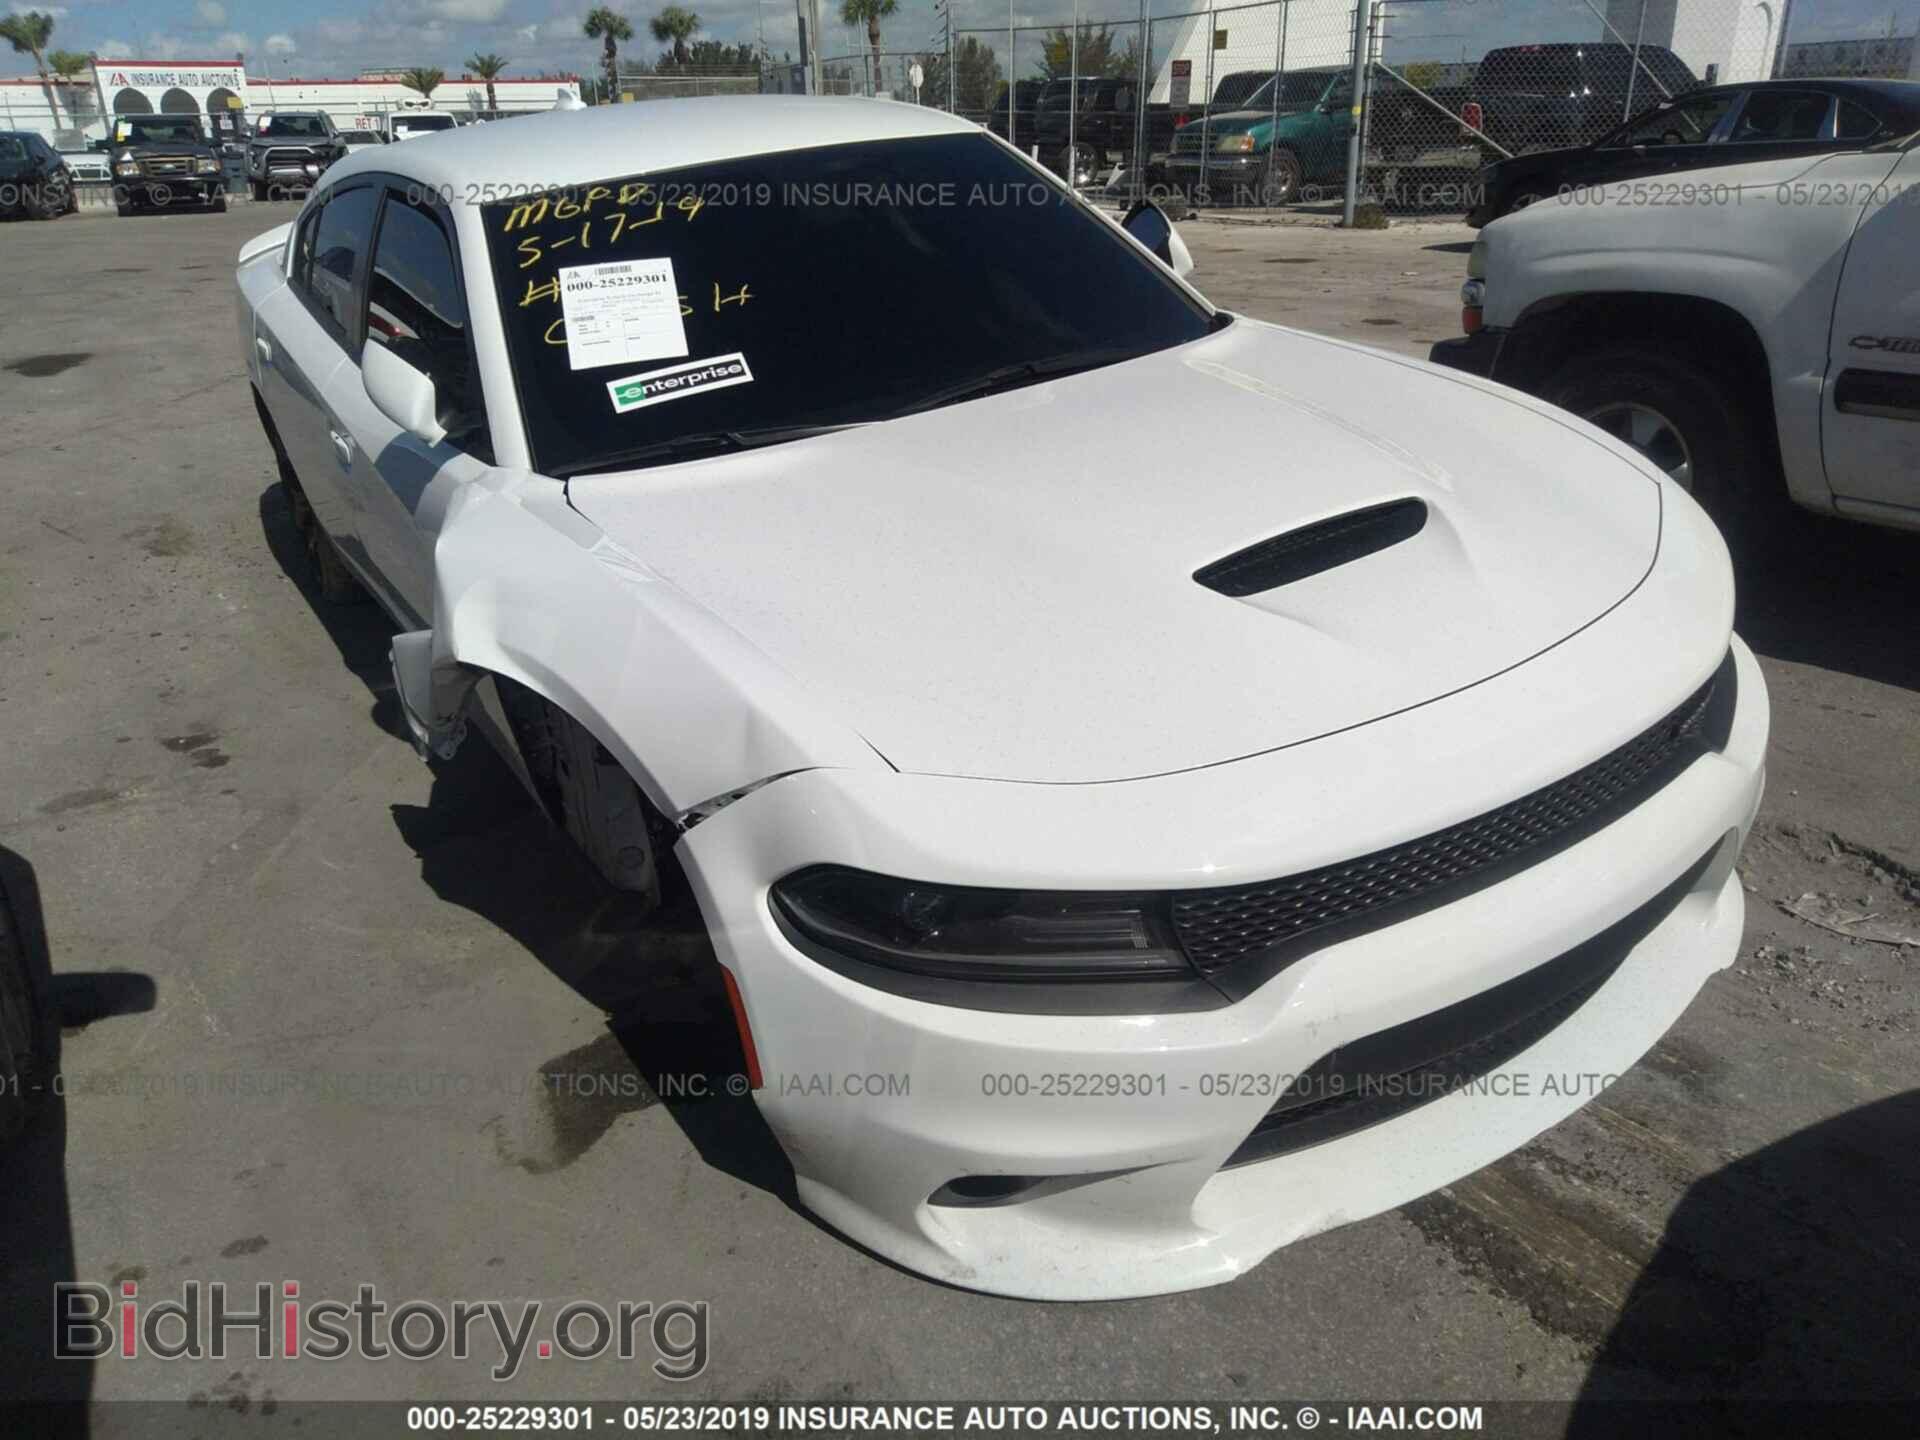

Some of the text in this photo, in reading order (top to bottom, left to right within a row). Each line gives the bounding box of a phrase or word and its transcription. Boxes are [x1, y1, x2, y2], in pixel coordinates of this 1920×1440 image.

[130, 73, 177, 86] INSURANCE
[178, 73, 199, 86] AUTO
[201, 73, 241, 86] AUCTIONS
[566, 274, 668, 292] 000-25229301
[618, 364, 743, 399] enterprise
